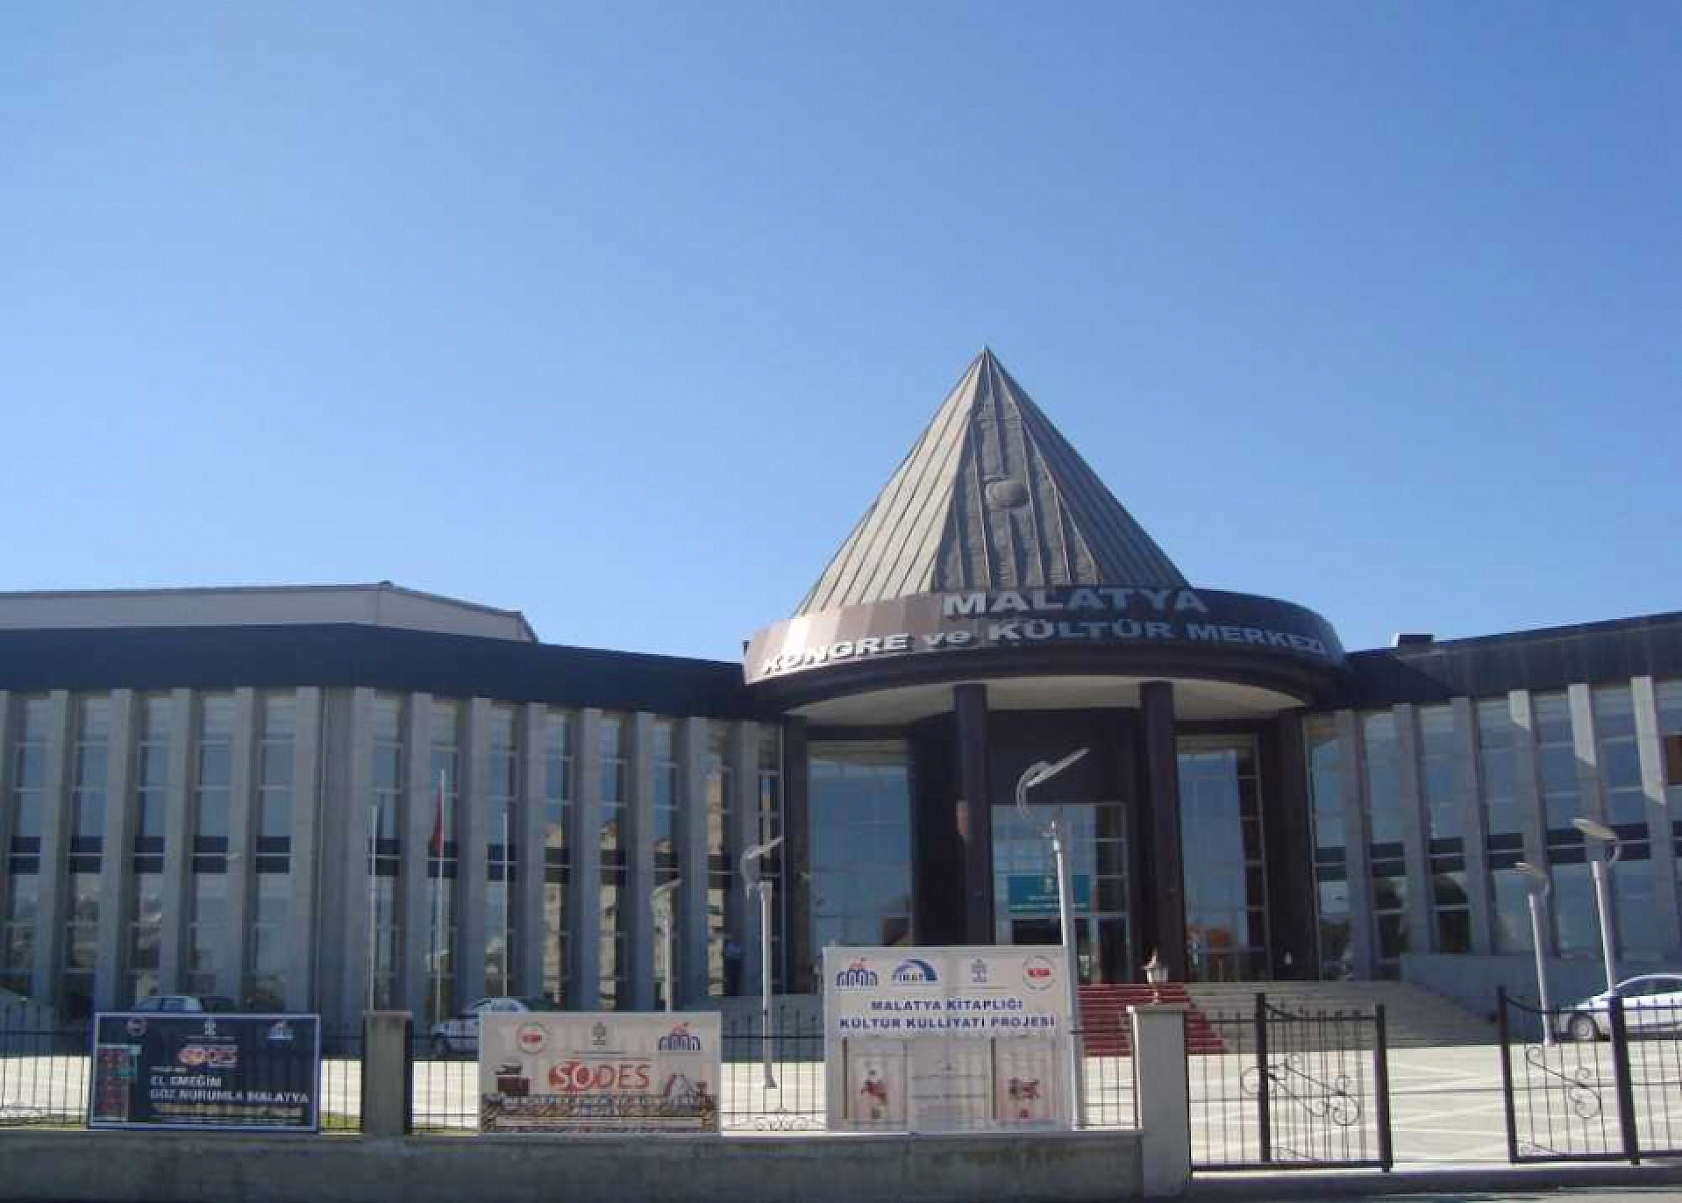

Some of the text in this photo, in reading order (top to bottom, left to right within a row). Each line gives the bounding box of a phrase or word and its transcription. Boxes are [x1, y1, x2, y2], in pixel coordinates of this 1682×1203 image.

[942, 588, 1209, 614] MALATYA
[764, 633, 909, 675] KONGRE
[922, 633, 962, 645] ve
[871, 1000, 942, 1011] MALATYA
